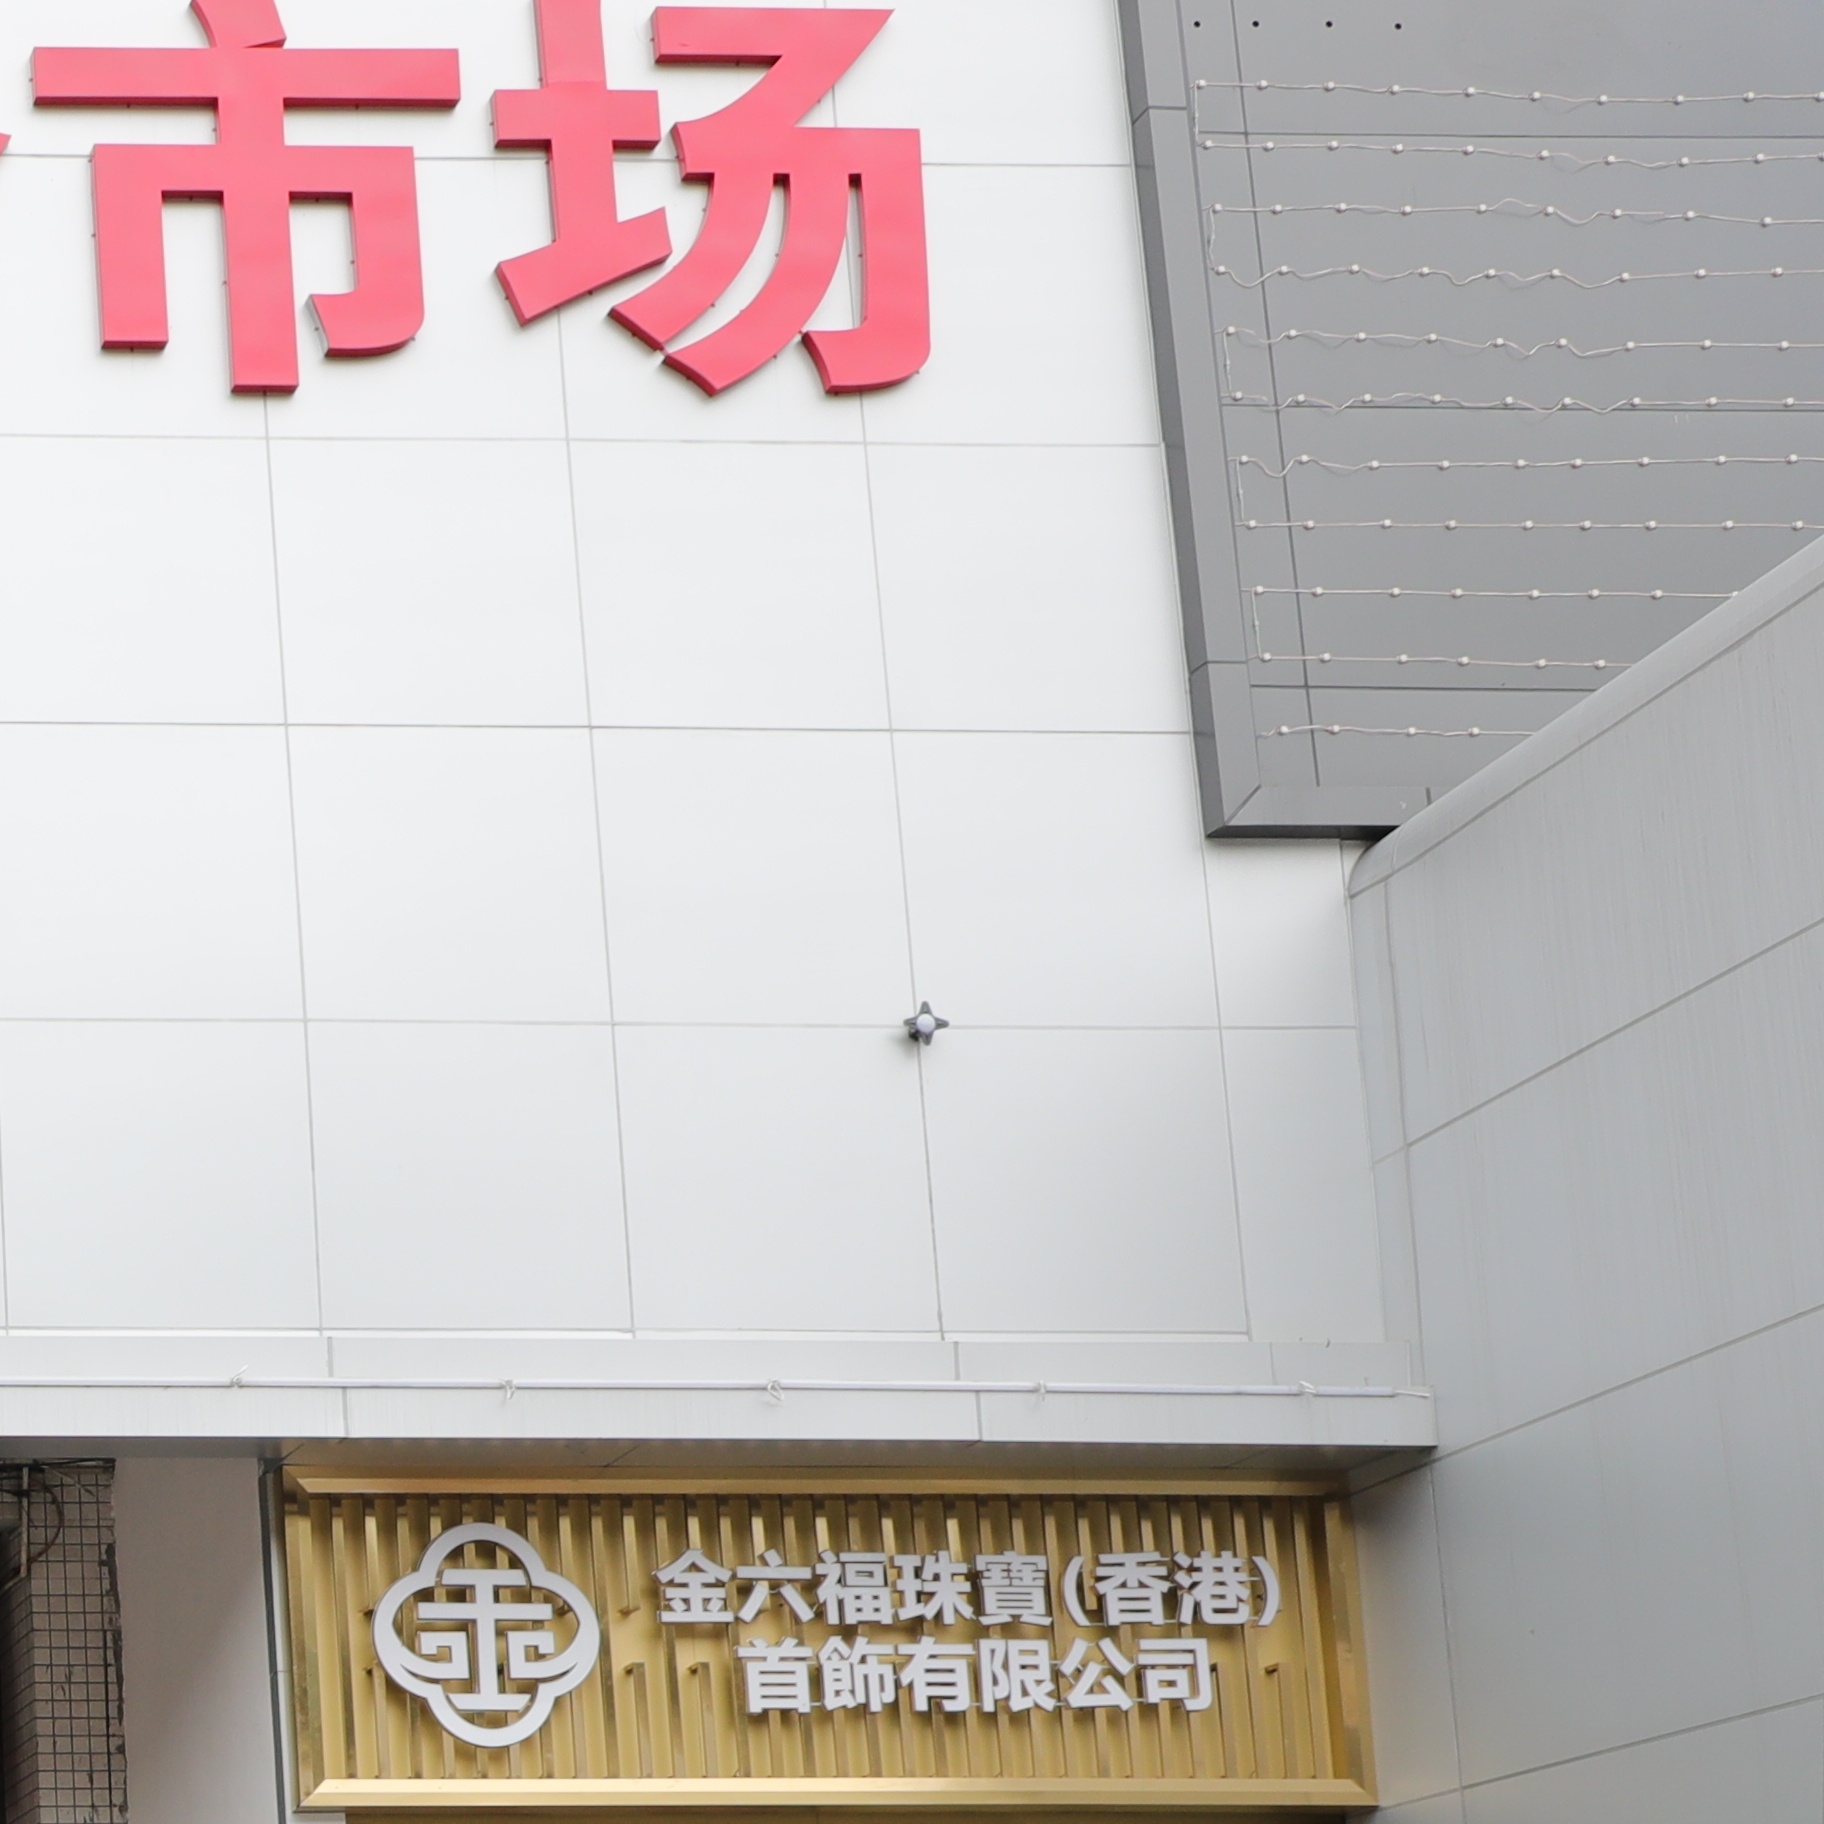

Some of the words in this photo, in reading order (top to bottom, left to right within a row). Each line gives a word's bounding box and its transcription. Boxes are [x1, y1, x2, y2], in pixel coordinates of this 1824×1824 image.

[748, 1637, 1215, 1714] 首飾有限公司
